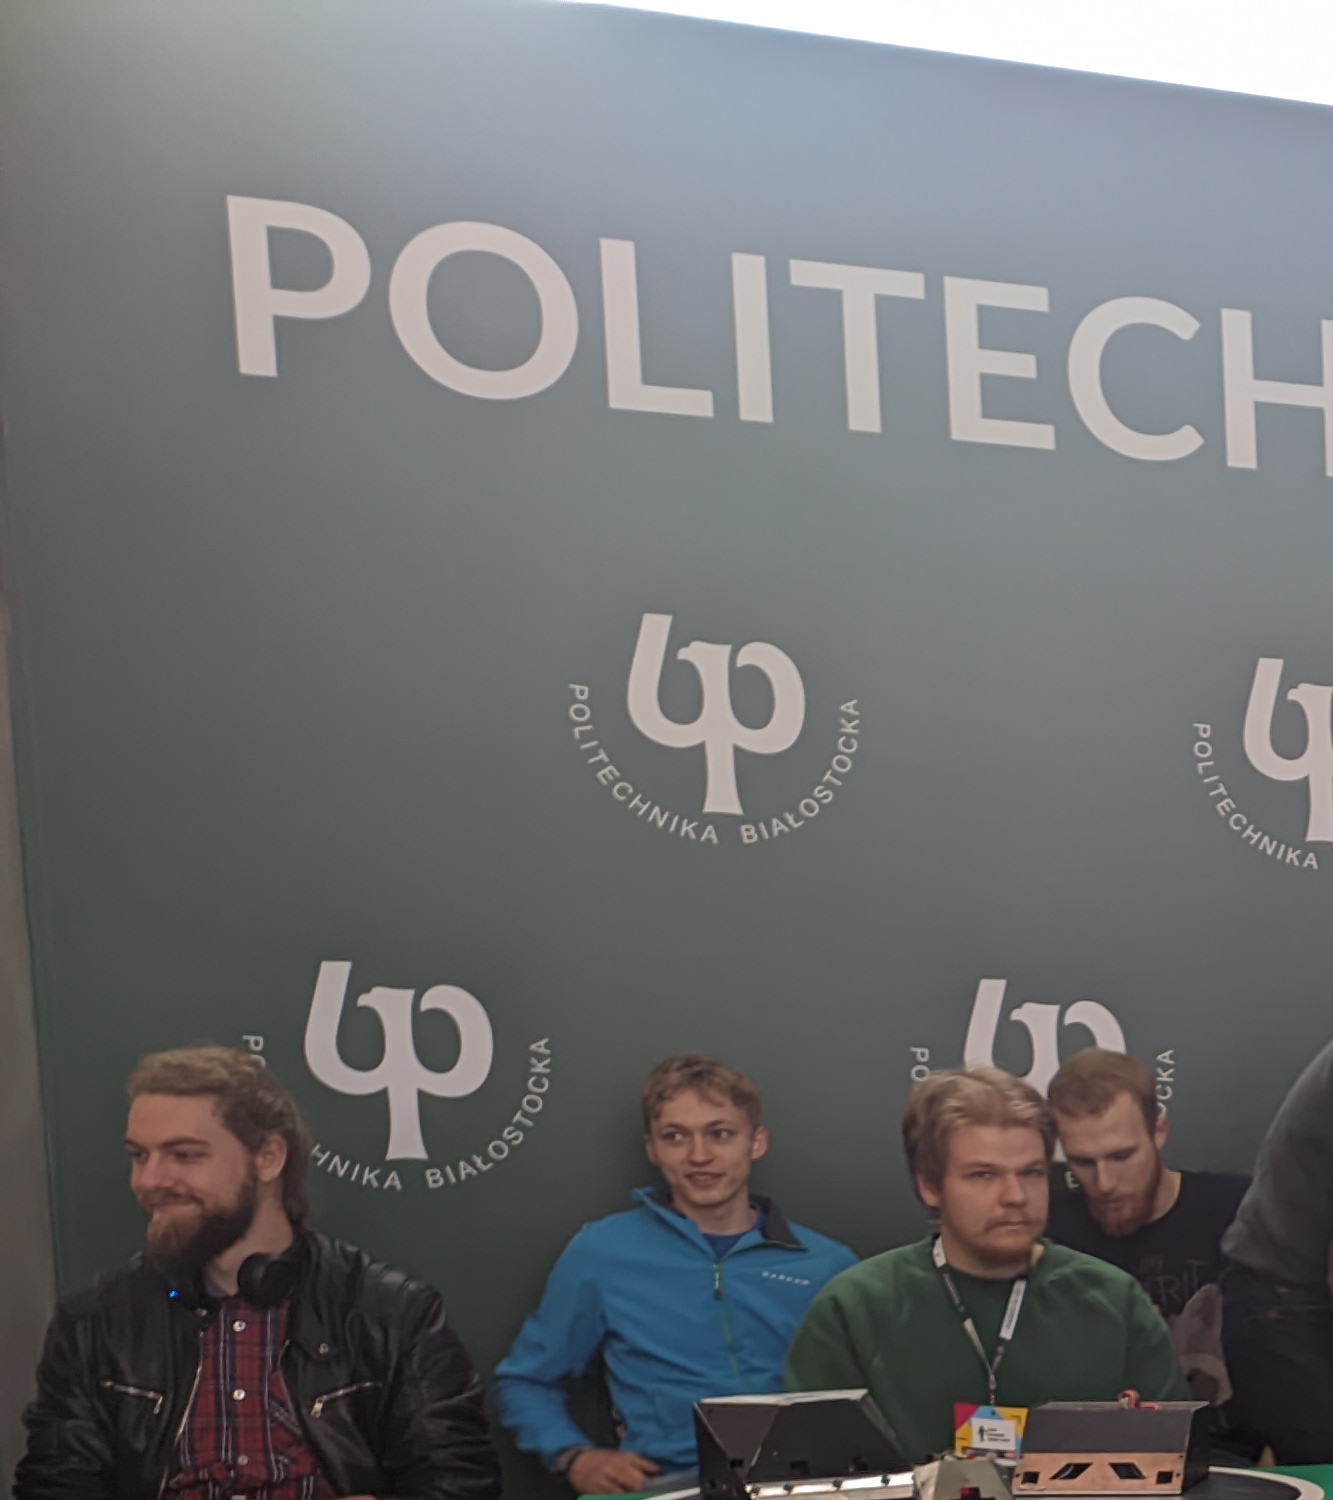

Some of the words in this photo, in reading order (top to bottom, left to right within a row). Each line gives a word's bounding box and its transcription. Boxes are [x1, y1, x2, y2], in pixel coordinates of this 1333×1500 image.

[567, 682, 719, 845] POLITECHNIKA
[739, 698, 862, 845] BIAŁOSTOCKA
[1193, 722, 1319, 870] POLITECHNIKA
[424, 1037, 552, 1189] BIAŁOSTOCKA
